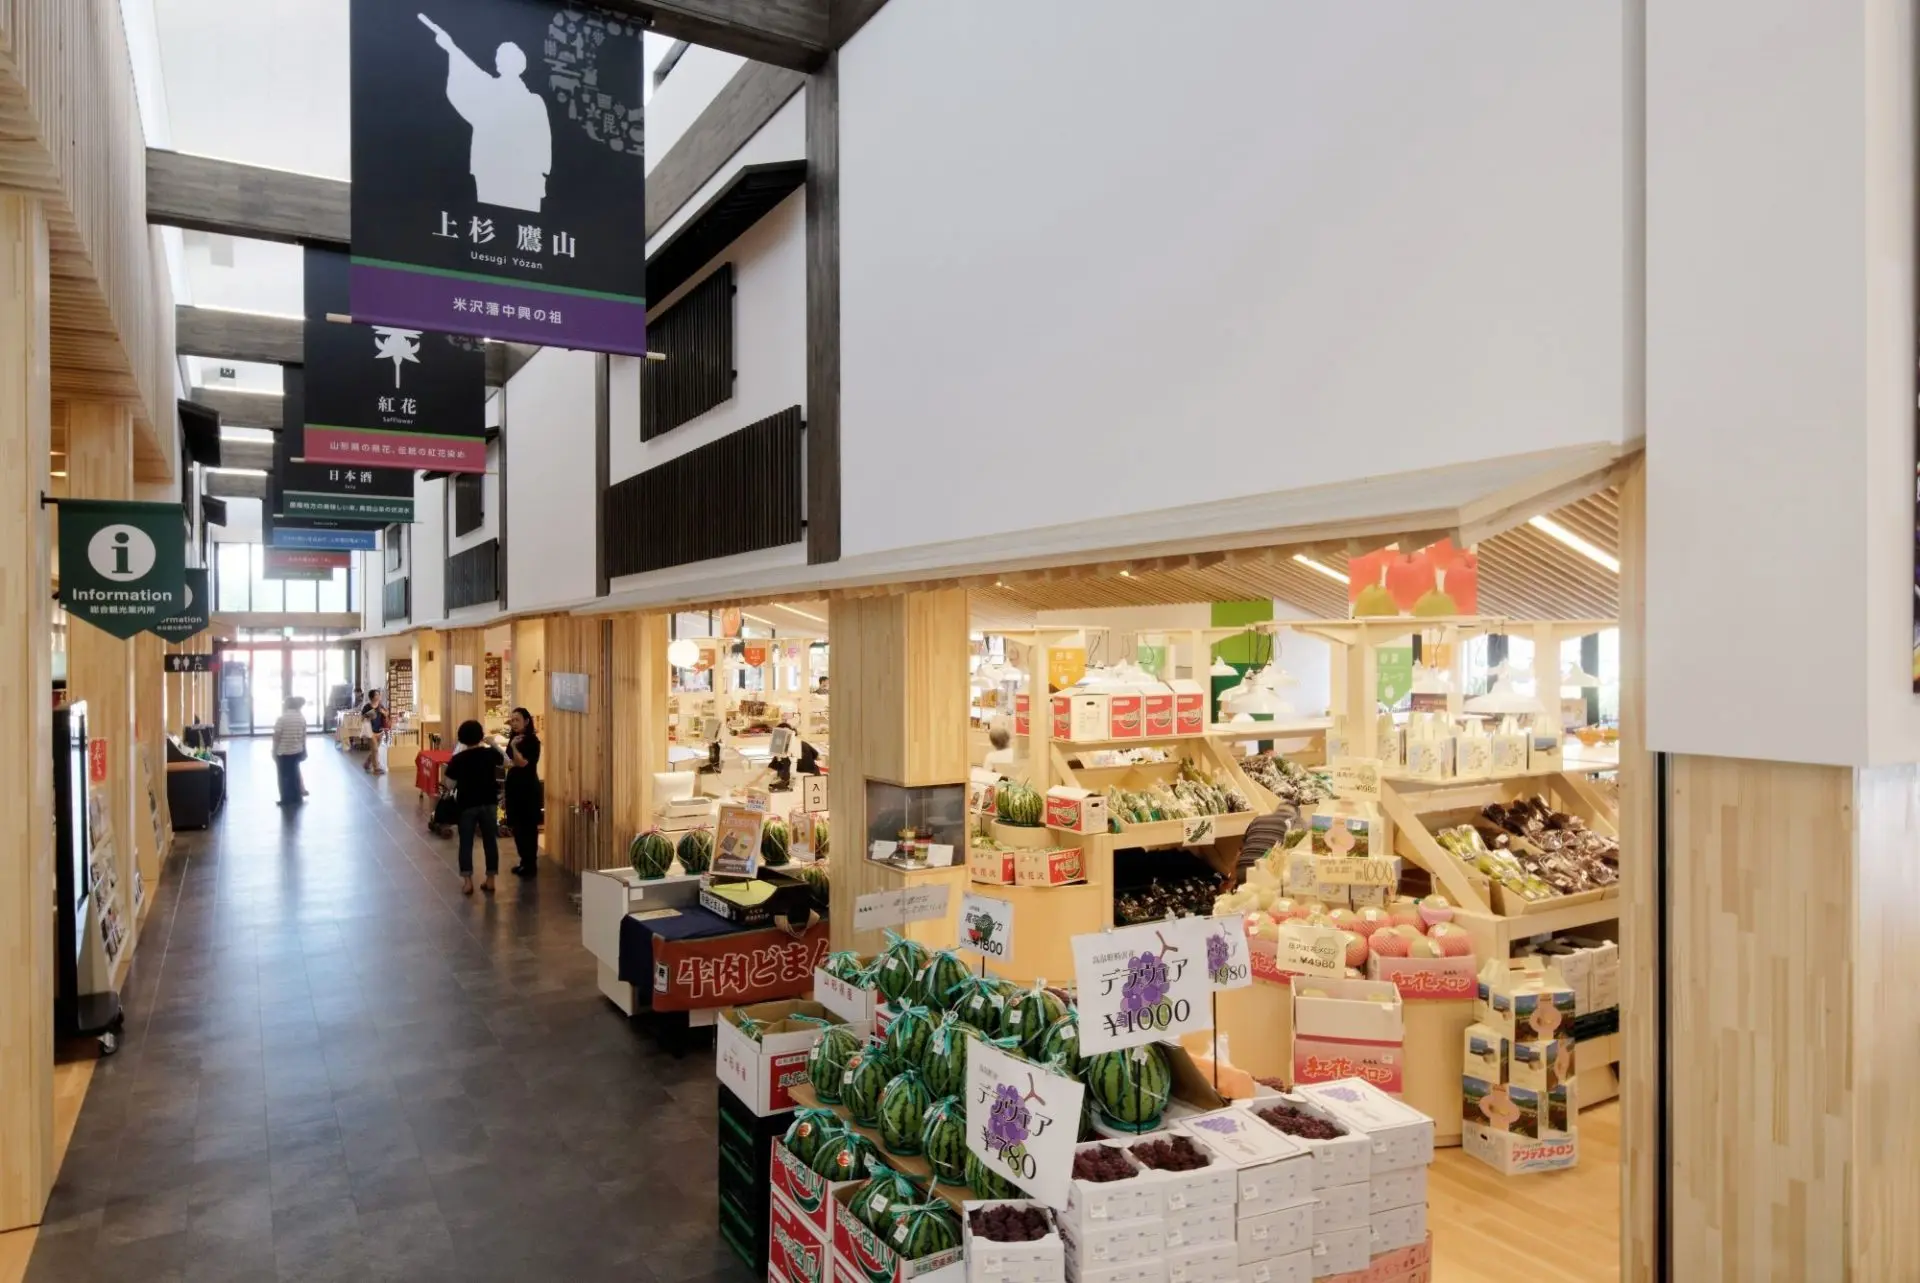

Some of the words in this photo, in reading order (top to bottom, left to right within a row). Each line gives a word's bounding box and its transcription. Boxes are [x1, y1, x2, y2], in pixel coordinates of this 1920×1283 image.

[432, 211, 496, 244] 上杉
[517, 225, 576, 258] 鷹山
[470, 251, 507, 265] Uesugi
[453, 298, 561, 324] 米沢藩中興の祖
[378, 396, 417, 415] 紅花
[329, 470, 373, 484] 日本酒
[73, 588, 173, 601] Information
[1299, 956, 1336, 969] ¥4980
[1391, 970, 1472, 992] 紅花メロン
[1103, 998, 1191, 1037] ¥1000
[1303, 1055, 1393, 1084] 紅花メロン
[980, 1125, 1037, 1180] ¥780
